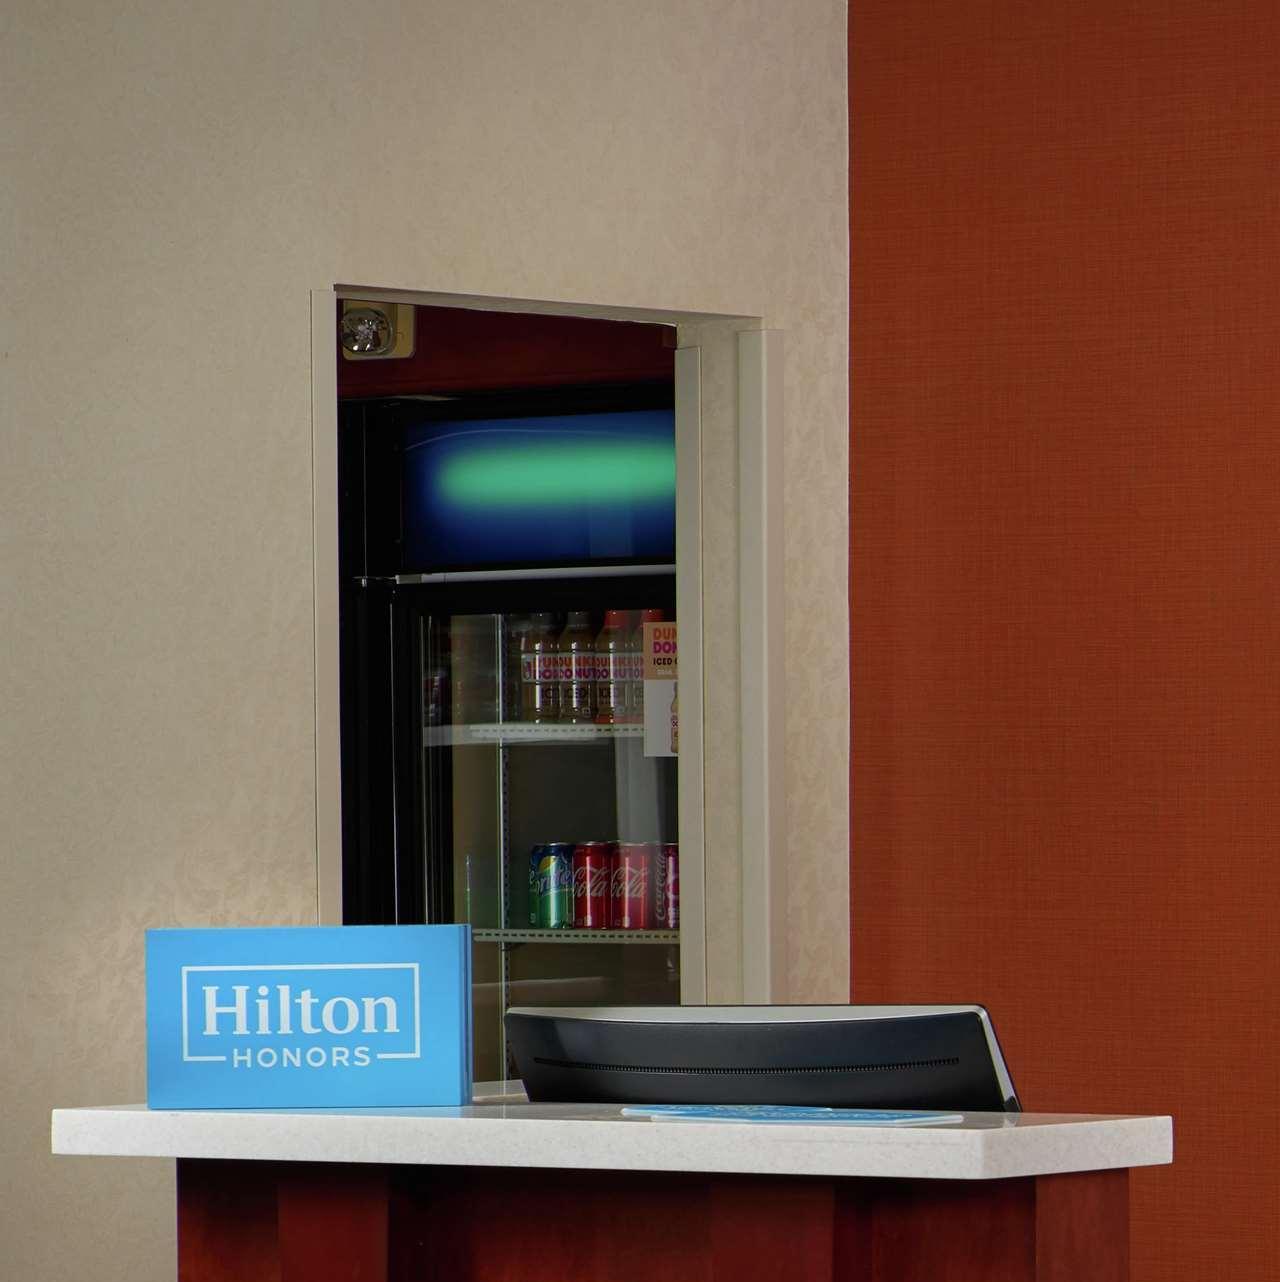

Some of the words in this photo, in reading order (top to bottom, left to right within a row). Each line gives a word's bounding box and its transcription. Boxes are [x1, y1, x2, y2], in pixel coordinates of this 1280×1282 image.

[653, 658, 673, 666] ICED
[202, 985, 400, 1036] Hilton
[233, 1046, 371, 1068] HONORS
